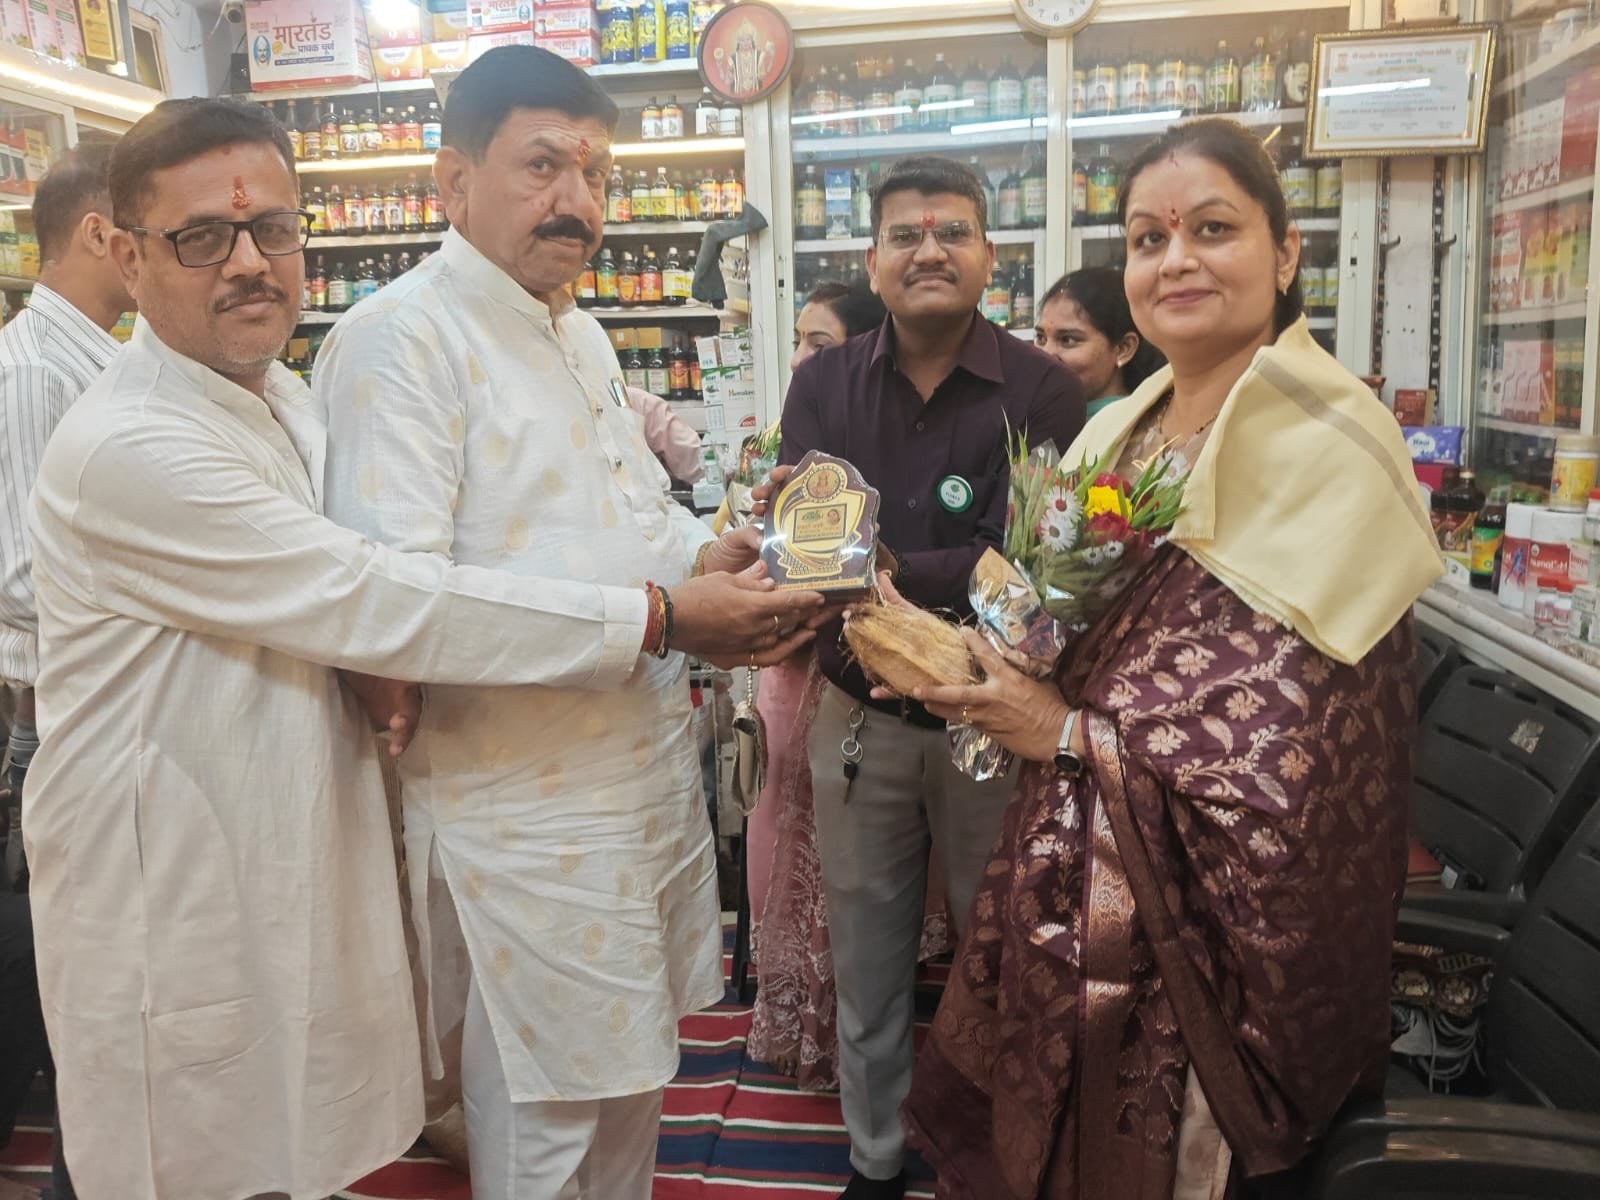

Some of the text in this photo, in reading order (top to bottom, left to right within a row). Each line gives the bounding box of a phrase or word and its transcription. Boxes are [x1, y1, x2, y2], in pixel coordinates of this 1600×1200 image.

[1038, 8, 1045, 18] 7
[1053, 11, 1059, 21] 6
[1068, 7, 1074, 16] 5
[272, 17, 332, 49] मारतंड
